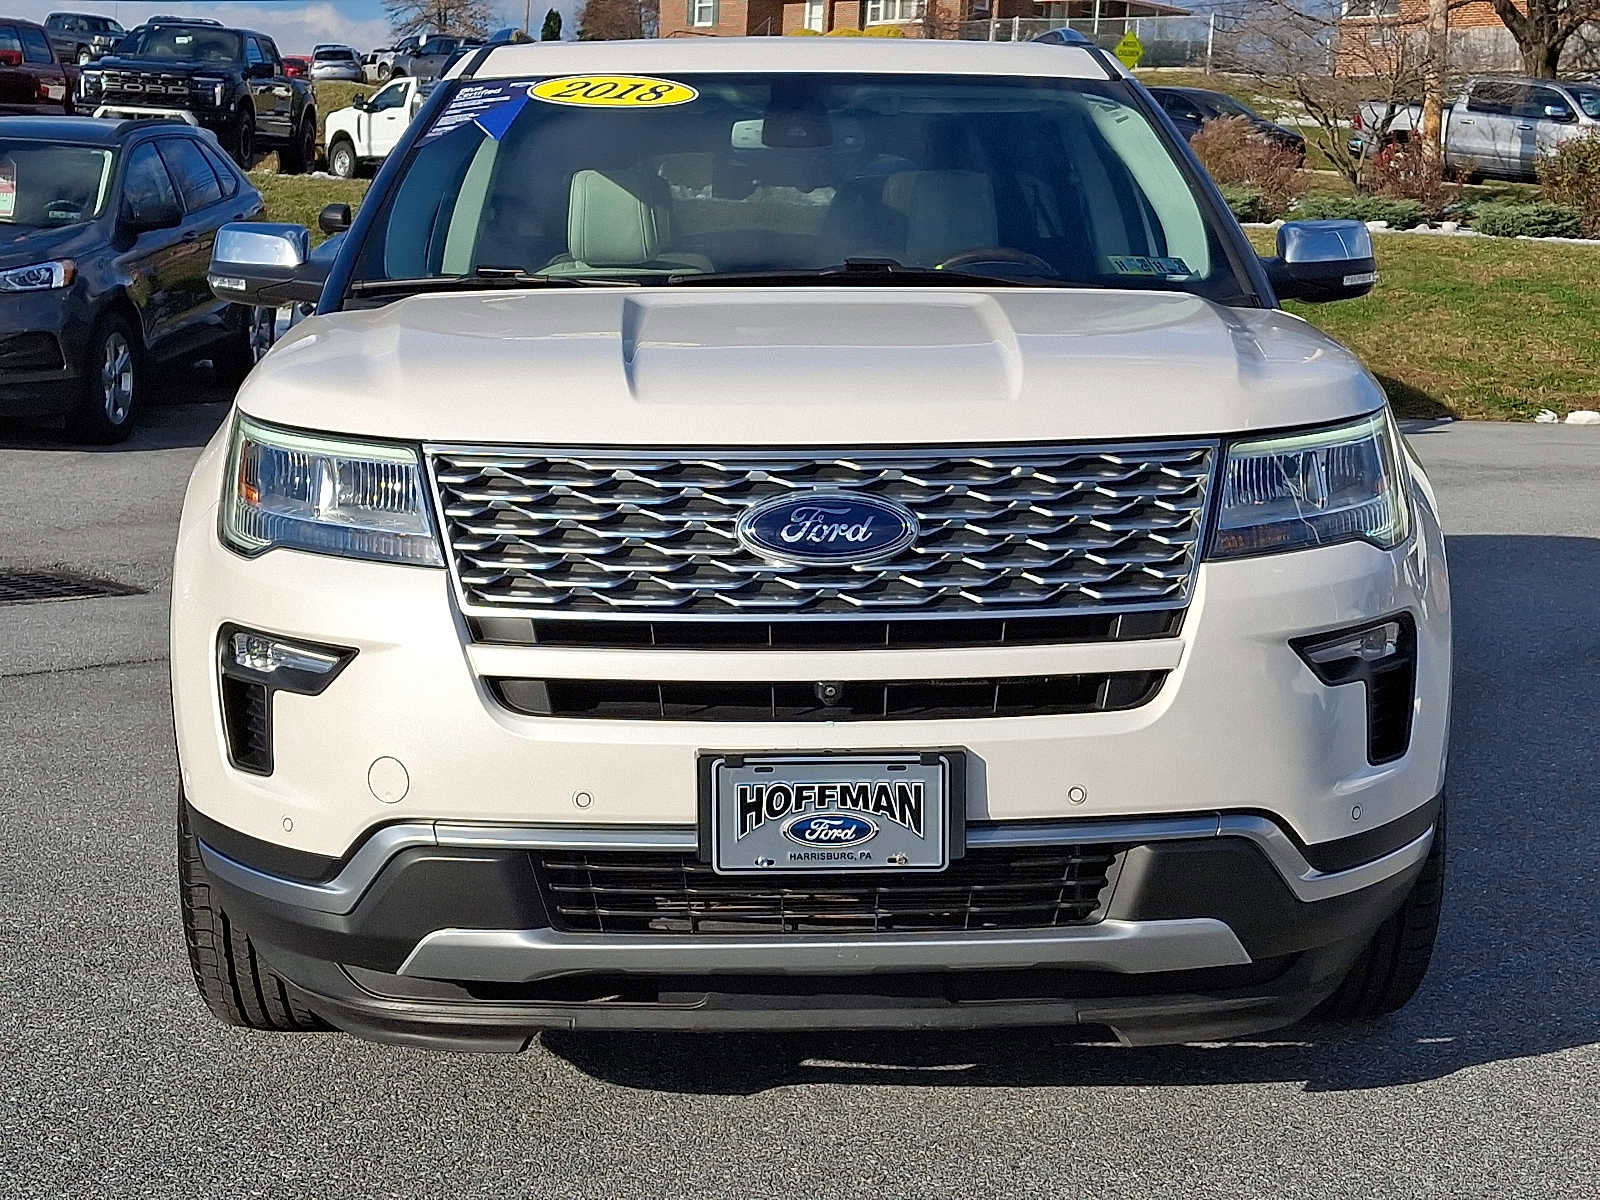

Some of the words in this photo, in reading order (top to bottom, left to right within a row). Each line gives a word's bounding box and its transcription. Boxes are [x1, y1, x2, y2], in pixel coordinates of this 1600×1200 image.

[105, 82, 189, 94] FORD
[456, 88, 503, 99] Certified
[557, 81, 674, 102] 2018
[780, 506, 876, 542] Ford
[736, 782, 925, 841] HOFFMAN
[805, 818, 857, 841] Ford
[789, 852, 857, 861] HARRISBURG,
[859, 852, 872, 861] PA
